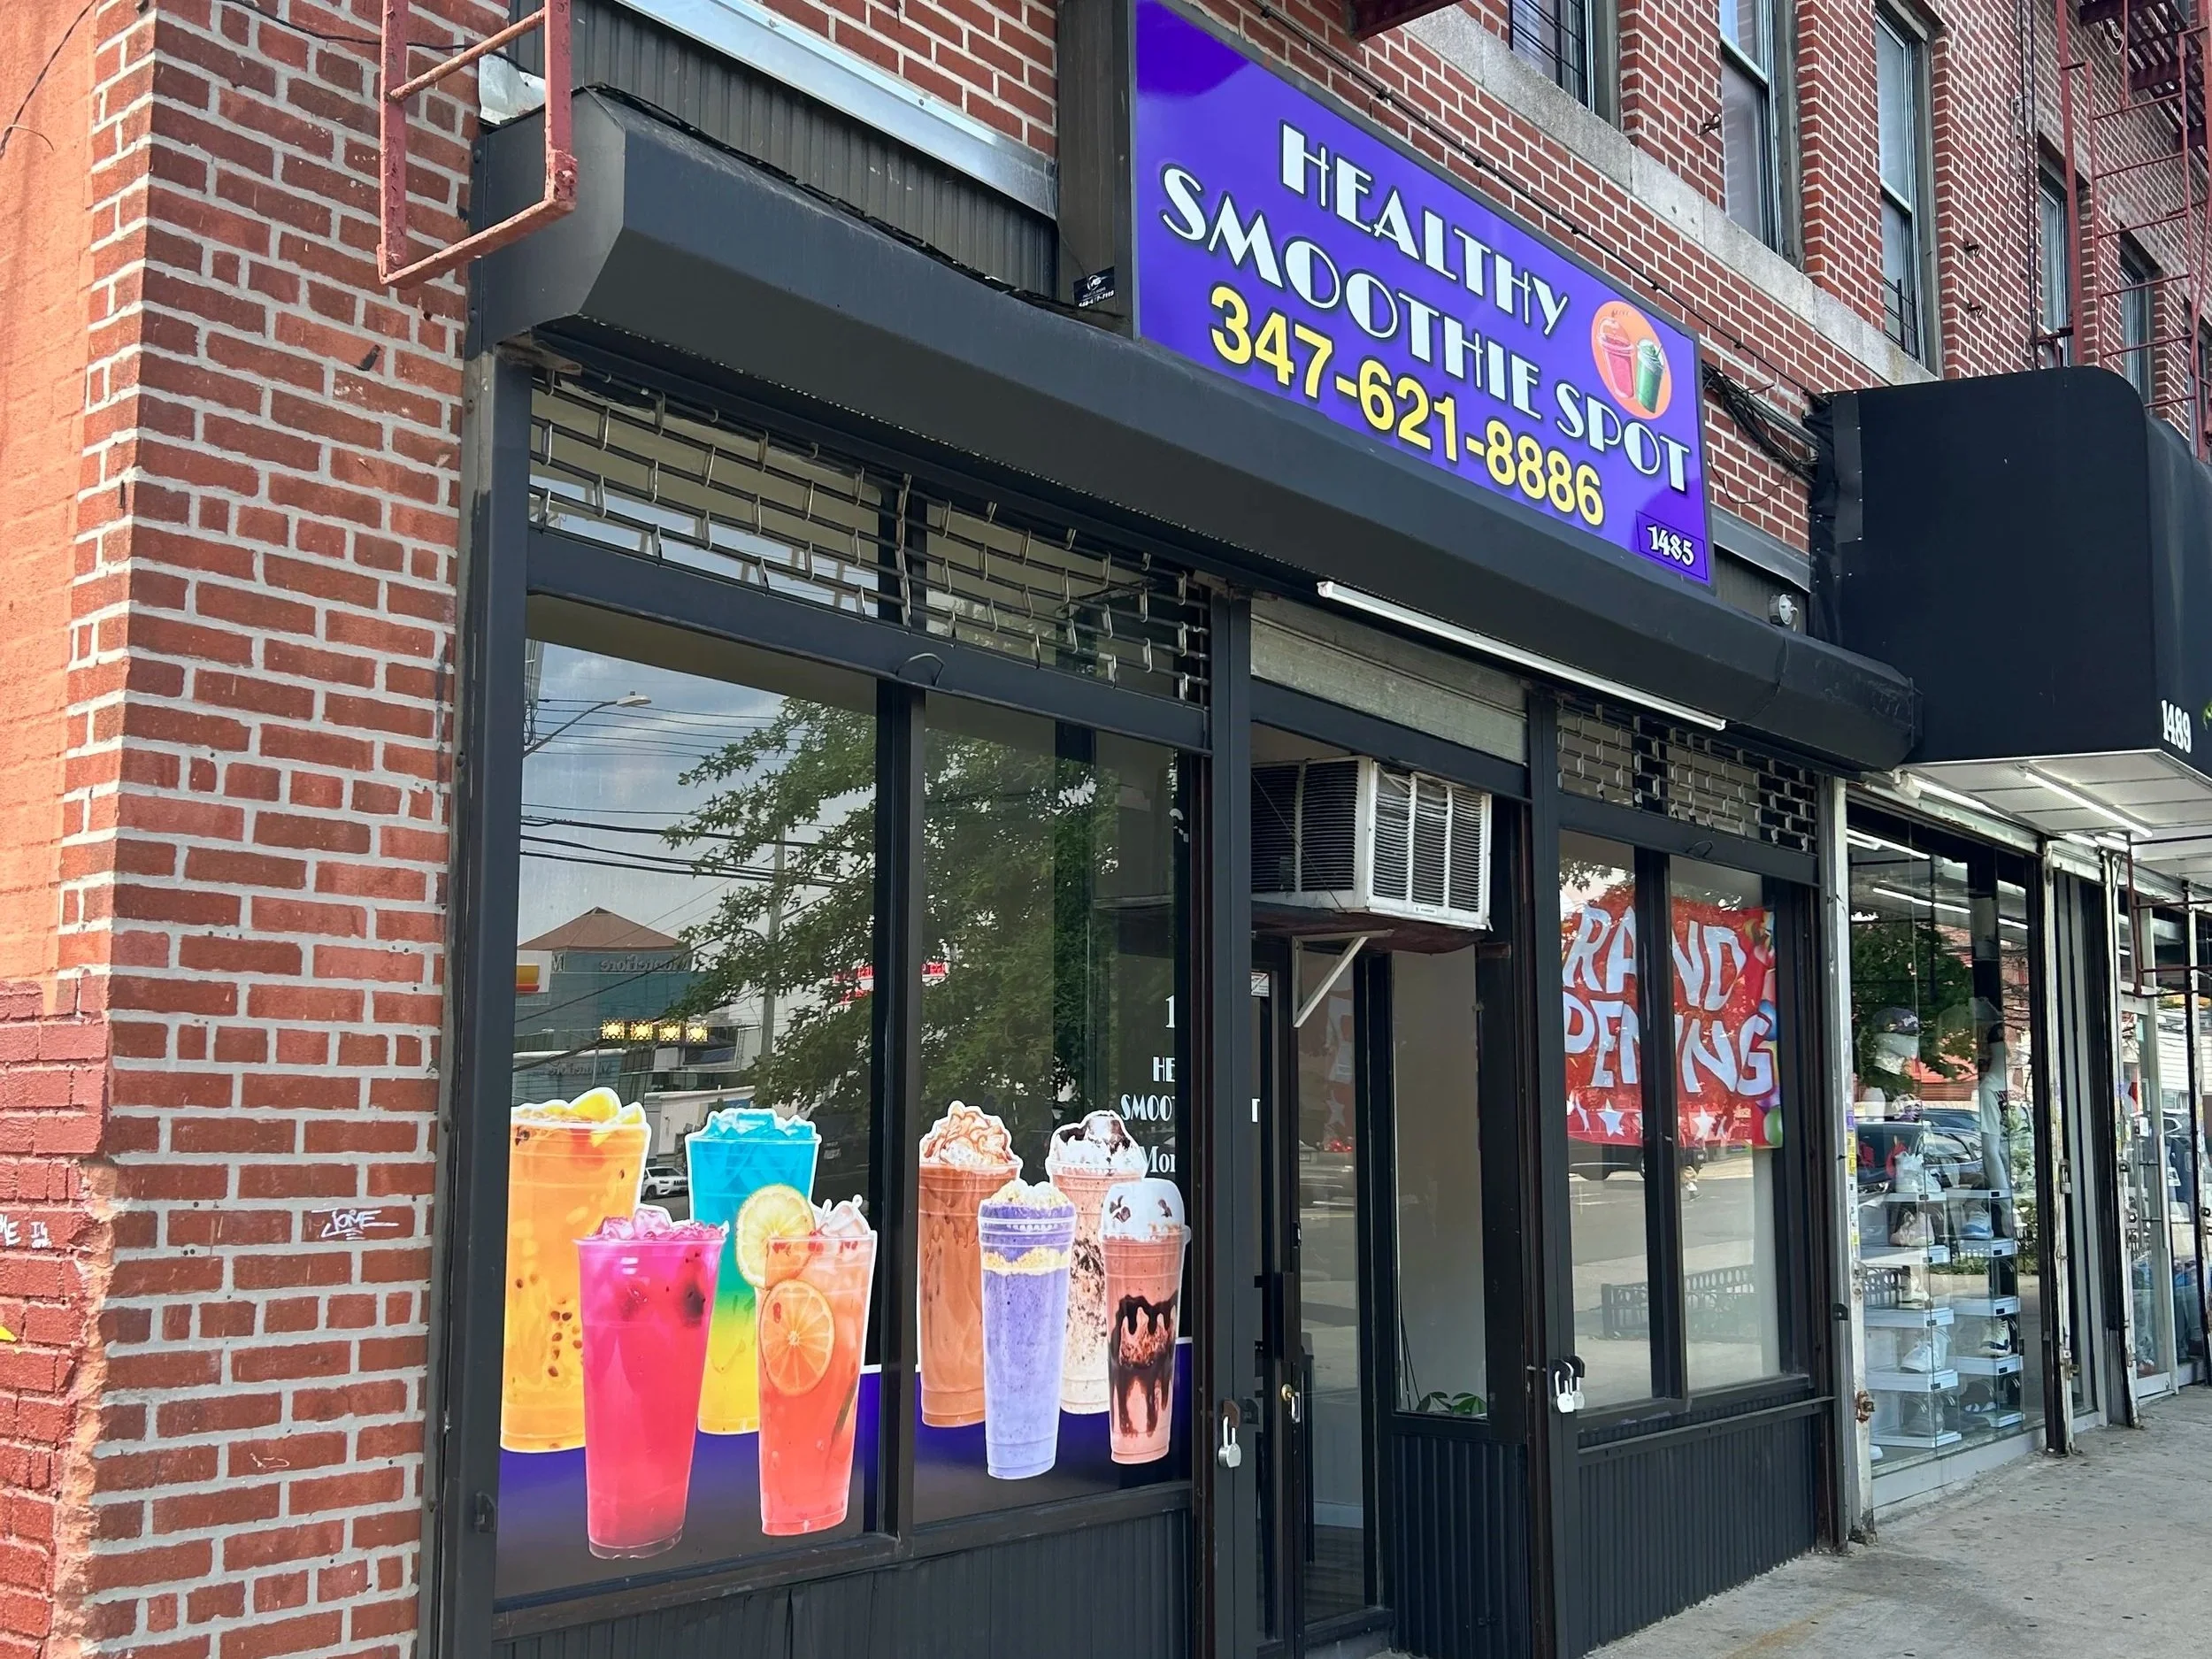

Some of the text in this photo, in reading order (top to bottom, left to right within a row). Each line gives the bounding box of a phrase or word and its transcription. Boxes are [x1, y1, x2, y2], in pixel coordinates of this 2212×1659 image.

[1280, 122, 1569, 334] HEALTHY
[1161, 168, 1691, 492] SMOOTHIE SPOT
[1210, 286, 1605, 526] 347-621-8886
[1647, 524, 1694, 567] 1485
[2161, 700, 2193, 754] 1489
[1562, 905, 1747, 1011] RAND
[1564, 991, 1773, 1096] PEING
[1120, 1094, 1176, 1122] SMOO
